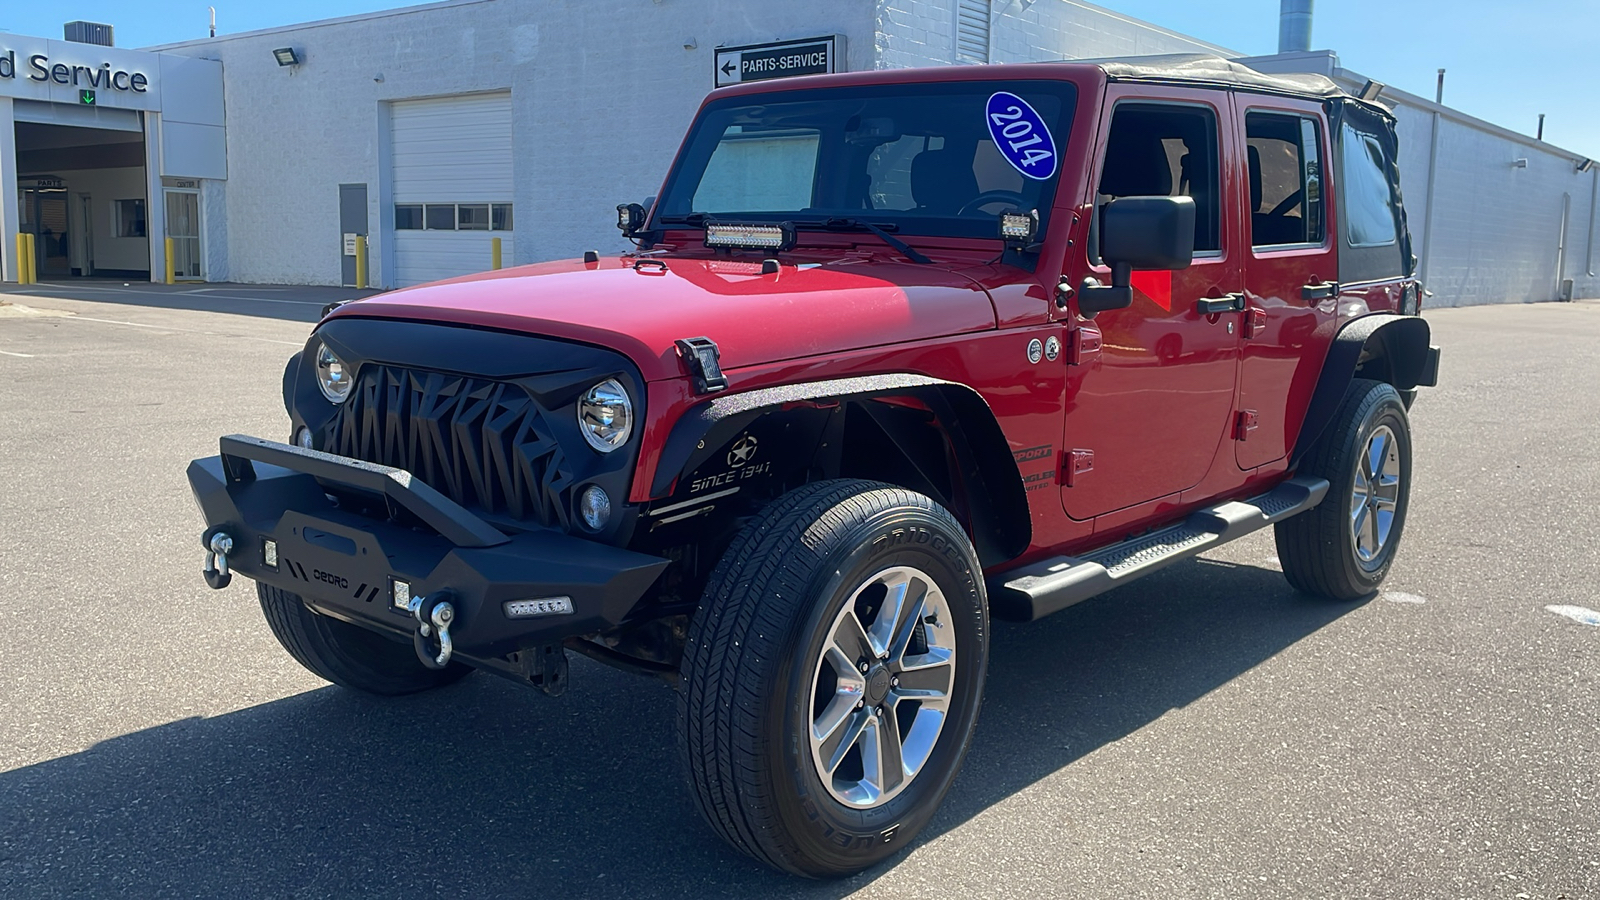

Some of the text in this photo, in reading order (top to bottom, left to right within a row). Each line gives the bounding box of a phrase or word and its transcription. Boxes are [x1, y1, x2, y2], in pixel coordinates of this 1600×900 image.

[29, 54, 148, 93] Service
[742, 52, 826, 73] PARTS-SERVICE
[990, 105, 1052, 167] 2014
[1023, 470, 1056, 483] NGLER
